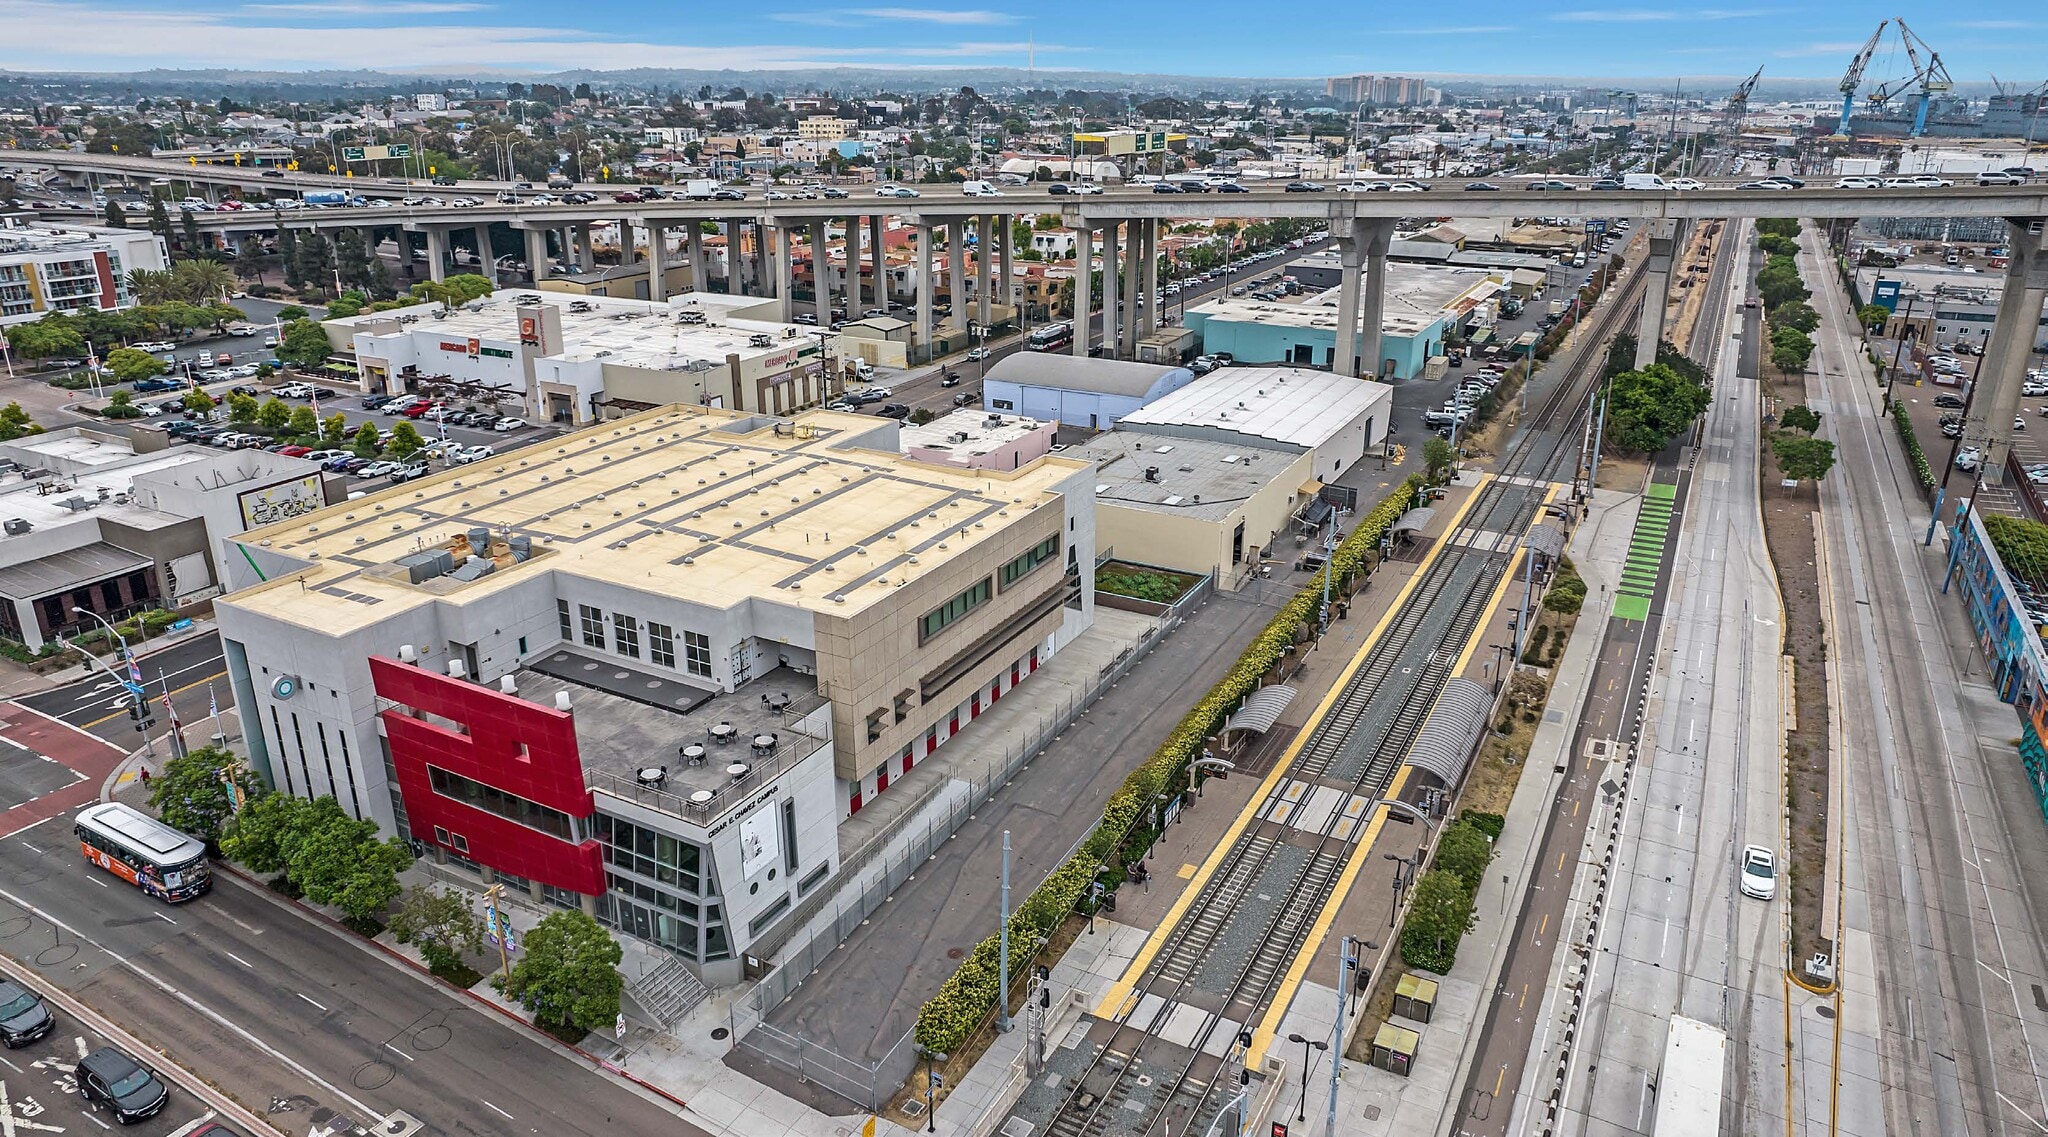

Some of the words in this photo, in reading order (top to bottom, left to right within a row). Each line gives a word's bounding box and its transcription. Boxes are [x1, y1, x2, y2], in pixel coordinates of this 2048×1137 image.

[708, 821, 728, 838] CESAR
[734, 801, 756, 820] CHAVEZ
[757, 785, 779, 804] CAMPUS
